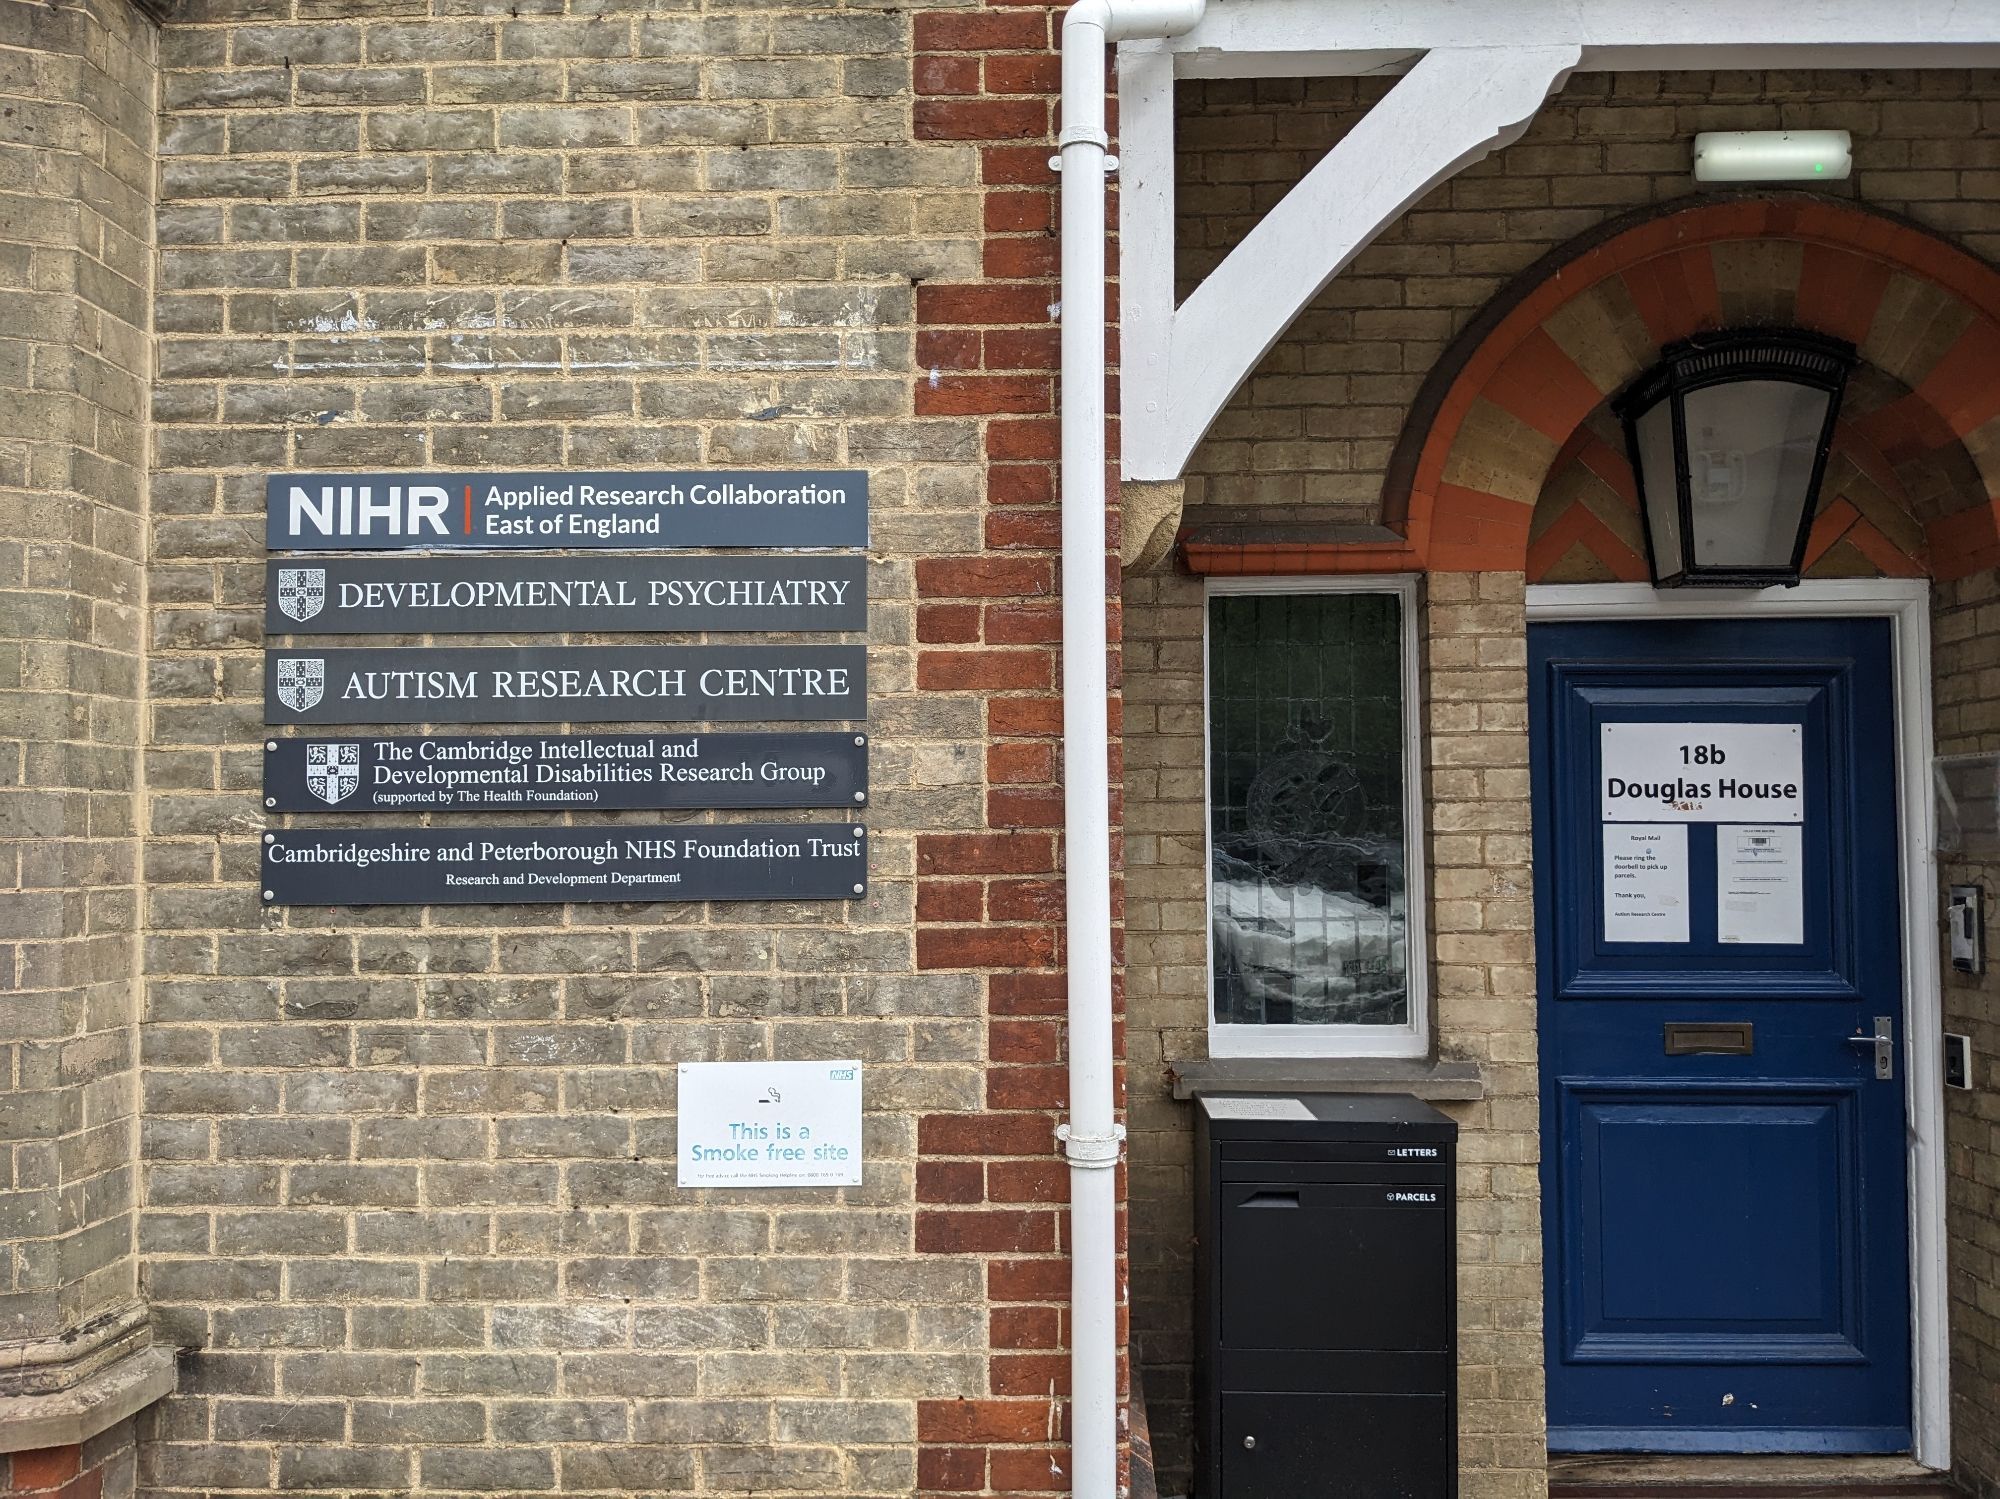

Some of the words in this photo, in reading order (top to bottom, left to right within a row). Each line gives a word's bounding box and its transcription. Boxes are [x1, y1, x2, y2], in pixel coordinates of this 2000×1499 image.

[485, 485, 573, 510] Applied
[581, 485, 683, 505] Research
[690, 484, 845, 504] Collaboration
[289, 487, 450, 535] NIHR
[487, 515, 534, 534] East
[540, 514, 563, 534] of
[570, 513, 659, 538] England
[339, 580, 636, 607] DEVELOPMENTAL
[648, 580, 850, 605] PSYCHIATRY
[341, 671, 478, 699] AUTISM
[492, 670, 686, 697] RESEARCH
[700, 668, 849, 696] CENTRE
[374, 742, 412, 760] The
[420, 741, 532, 765] Cambridge
[540, 740, 654, 758] Intellectual
[662, 738, 698, 757] and
[1680, 744, 1725, 764] 18b
[374, 763, 529, 787] Developmental
[536, 763, 652, 782] Disabilities
[659, 762, 753, 781] Research
[761, 762, 825, 786] Group
[373, 791, 435, 805] (supported
[439, 791, 453, 804] by
[457, 791, 479, 801] The
[484, 790, 522, 801] Health
[527, 789, 598, 802] Foundation)
[1608, 778, 1711, 803] Douglas
[1719, 779, 1797, 798] House
[268, 842, 431, 867] Cambridgeshire
[437, 842, 473, 861] and
[480, 841, 618, 864] Peterborough
[625, 840, 675, 859] NHS
[684, 839, 800, 858] Foundation
[807, 837, 861, 857] Trust
[446, 874, 499, 885] Research
[503, 873, 524, 884] and
[528, 873, 607, 886] Development
[611, 872, 681, 886] Department
[831, 1070, 853, 1080] NHS
[729, 1123, 768, 1139] This
[777, 1123, 790, 1139] is
[799, 1127, 809, 1139] a
[692, 1144, 758, 1161] Smoke
[766, 1143, 805, 1160] free
[814, 1143, 848, 1160] site
[1396, 1148, 1438, 1157] LETTERS
[1396, 1192, 1436, 1202] PARCELS
